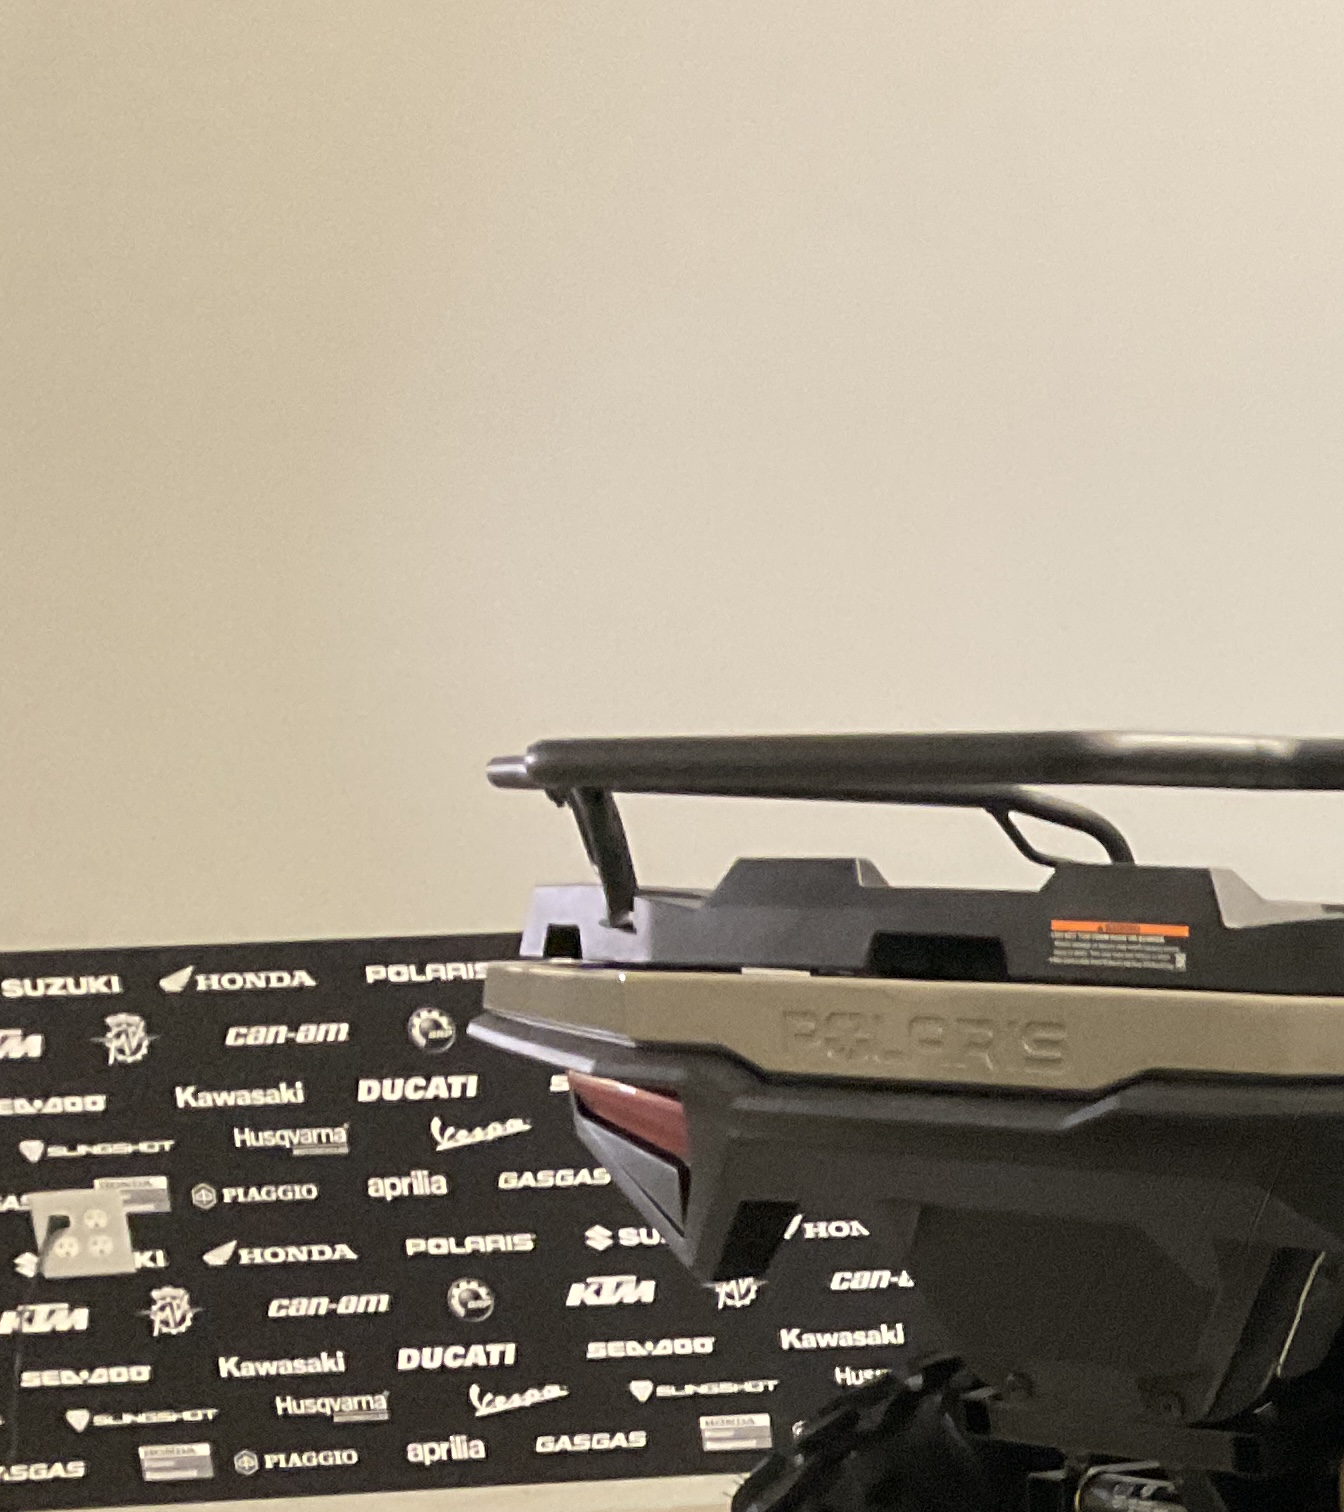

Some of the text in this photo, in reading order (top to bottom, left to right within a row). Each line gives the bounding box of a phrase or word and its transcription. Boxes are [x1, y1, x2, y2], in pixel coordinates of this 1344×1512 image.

[2, 975, 122, 998] SUZUKI
[196, 969, 316, 991] HONDA
[225, 1022, 350, 1047] can-am
[175, 1082, 305, 1109] Kawasaki
[358, 1075, 479, 1102] DUCATI
[430, 1117, 531, 1151] Vespa
[368, 1171, 447, 1201] aprilia
[498, 1168, 611, 1190] GASGAS
[222, 1183, 318, 1204] PIAGGIO
[803, 1220, 870, 1240] HON
[239, 1242, 358, 1264] HONDA
[406, 1233, 537, 1255] POLARIS
[566, 1275, 656, 1306] KTM
[268, 1293, 391, 1318] can-am
[0, 1303, 90, 1336] KTM
[780, 1322, 905, 1350] Kawasaki
[218, 1351, 346, 1378] Kawasaki
[398, 1342, 516, 1370] DUCATI
[468, 1384, 569, 1417] Vespa
[406, 1435, 487, 1464] aprilia
[535, 1431, 647, 1454] GASGAS
[0, 1461, 86, 1482] ASGAS
[264, 1449, 359, 1469] PIAGGIO
